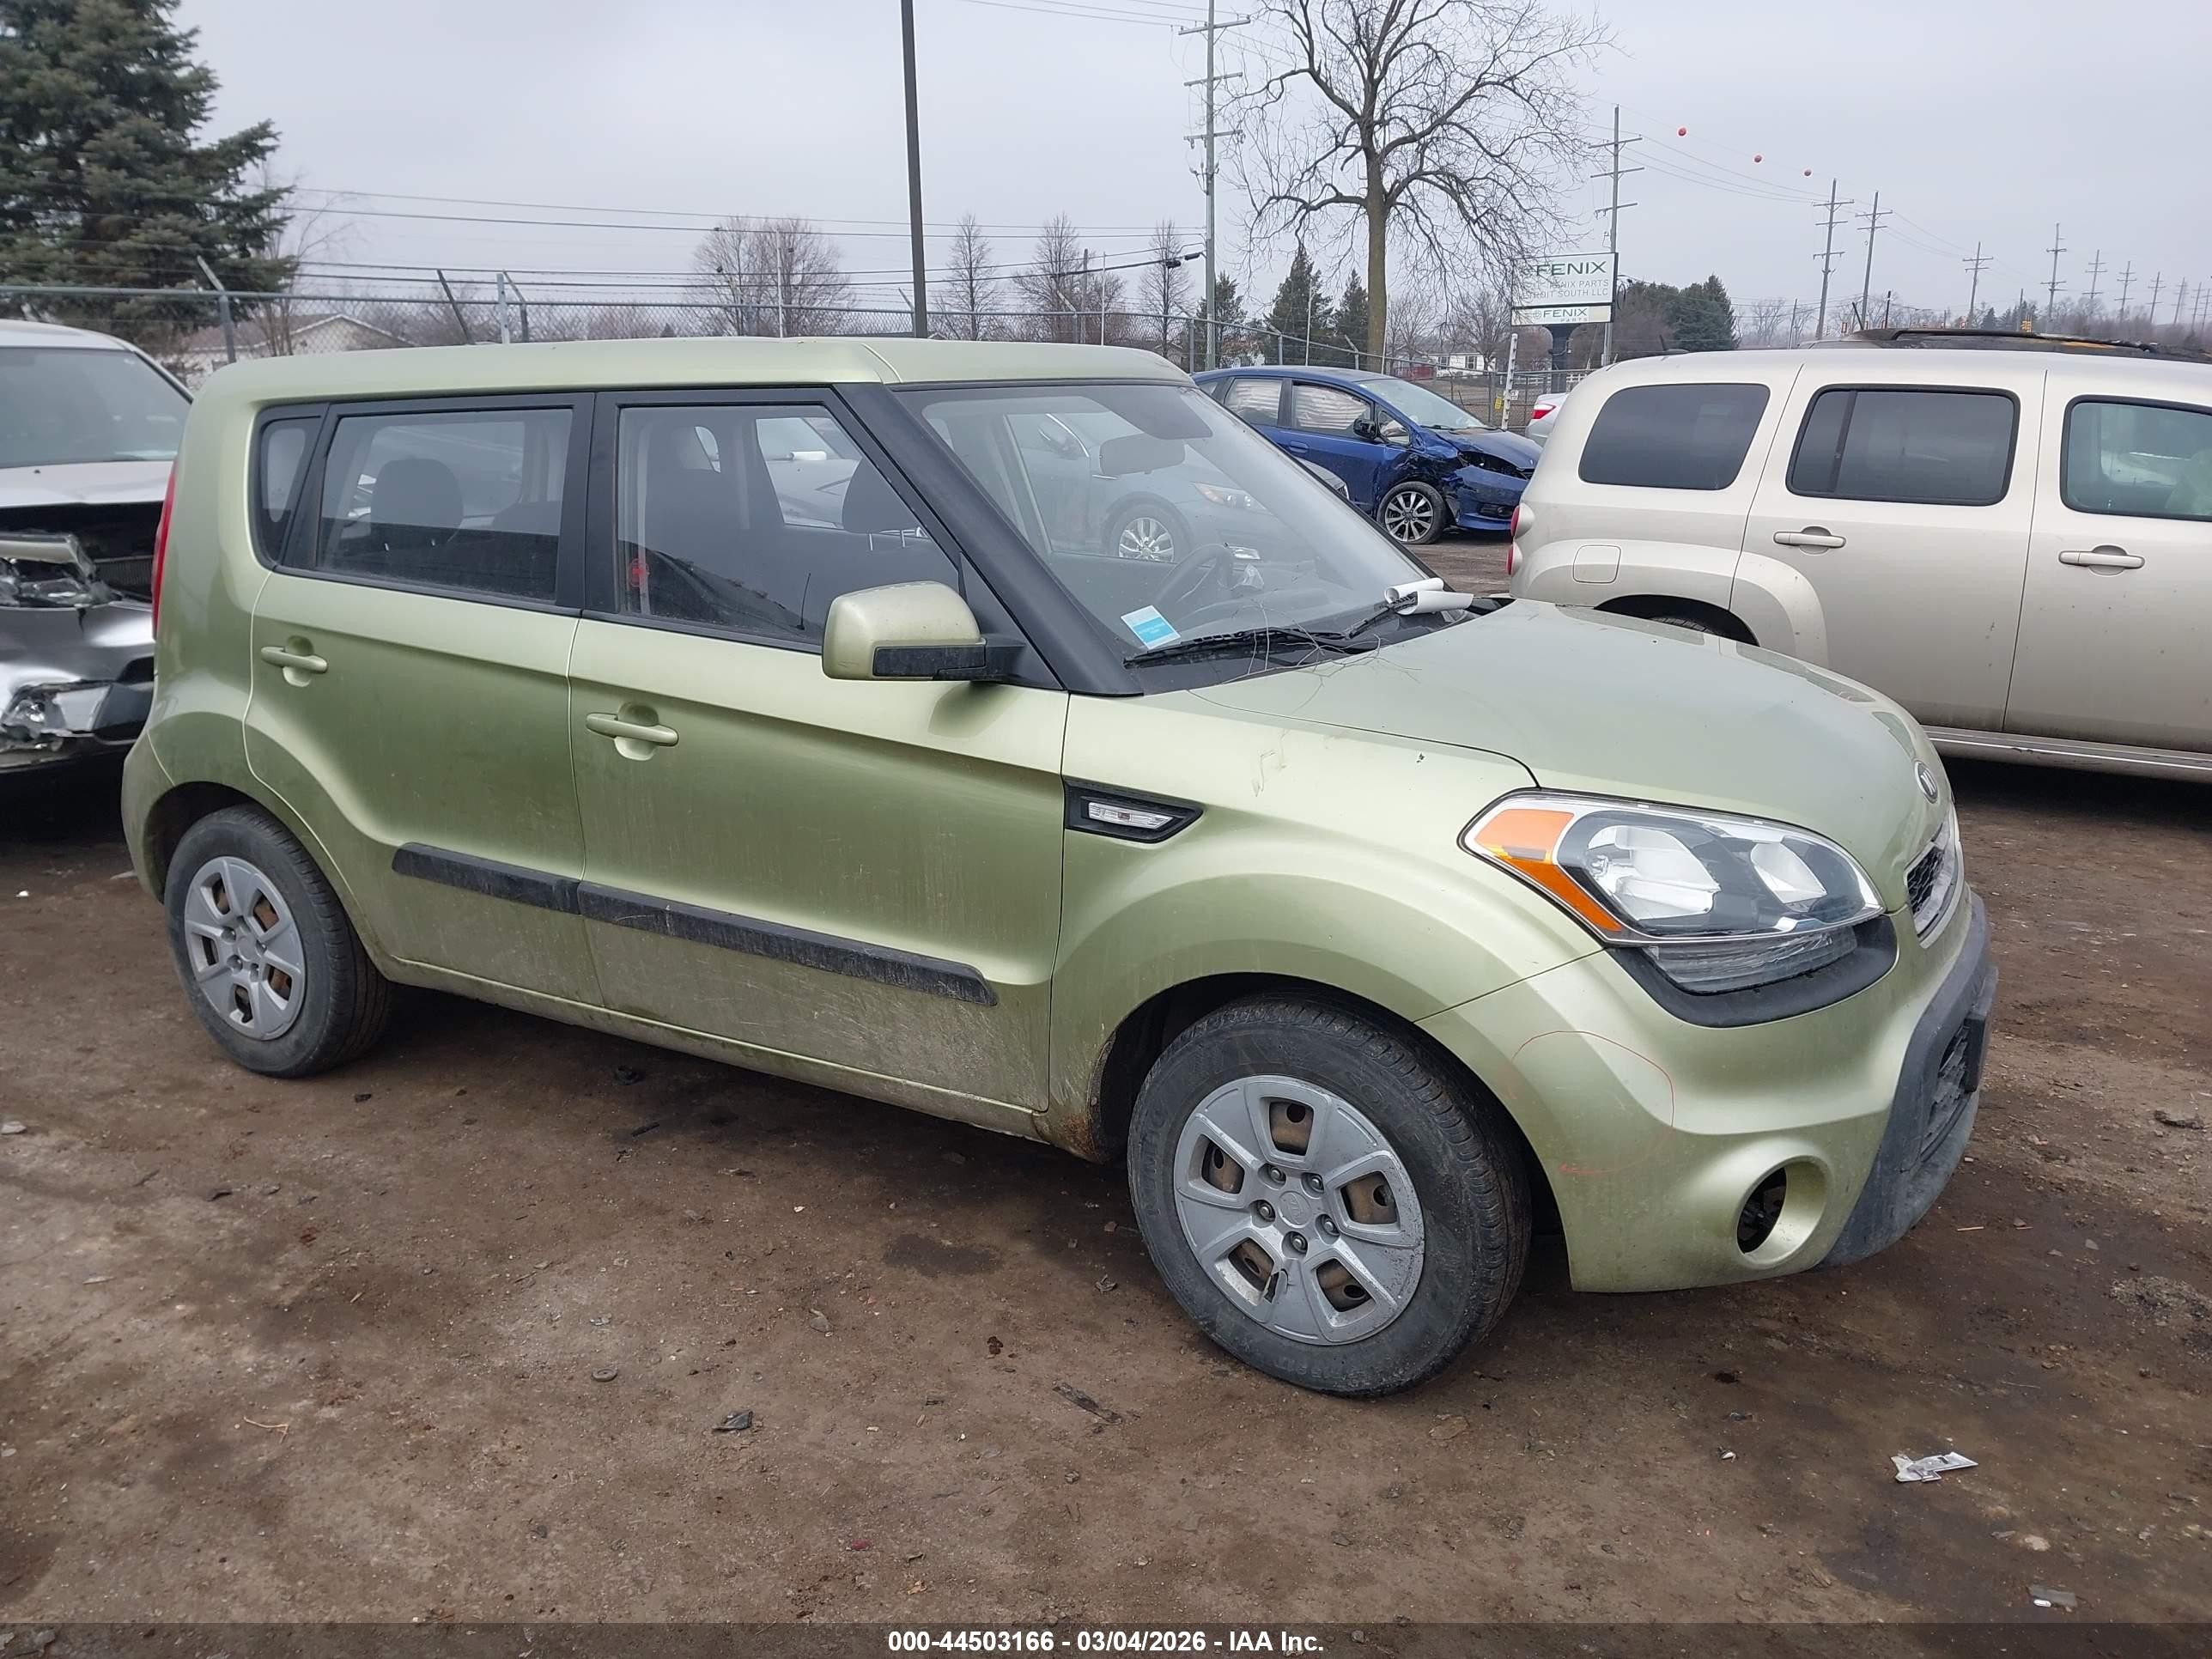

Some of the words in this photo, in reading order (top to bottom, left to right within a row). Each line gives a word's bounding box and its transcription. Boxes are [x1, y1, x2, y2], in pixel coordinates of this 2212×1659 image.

[1534, 261, 1607, 276] FENIX
[1578, 279, 1609, 289] PARTS
[1558, 289, 1589, 298] SOUTH
[1591, 288, 1608, 297] LLC
[1543, 307, 1588, 319] FENIX
